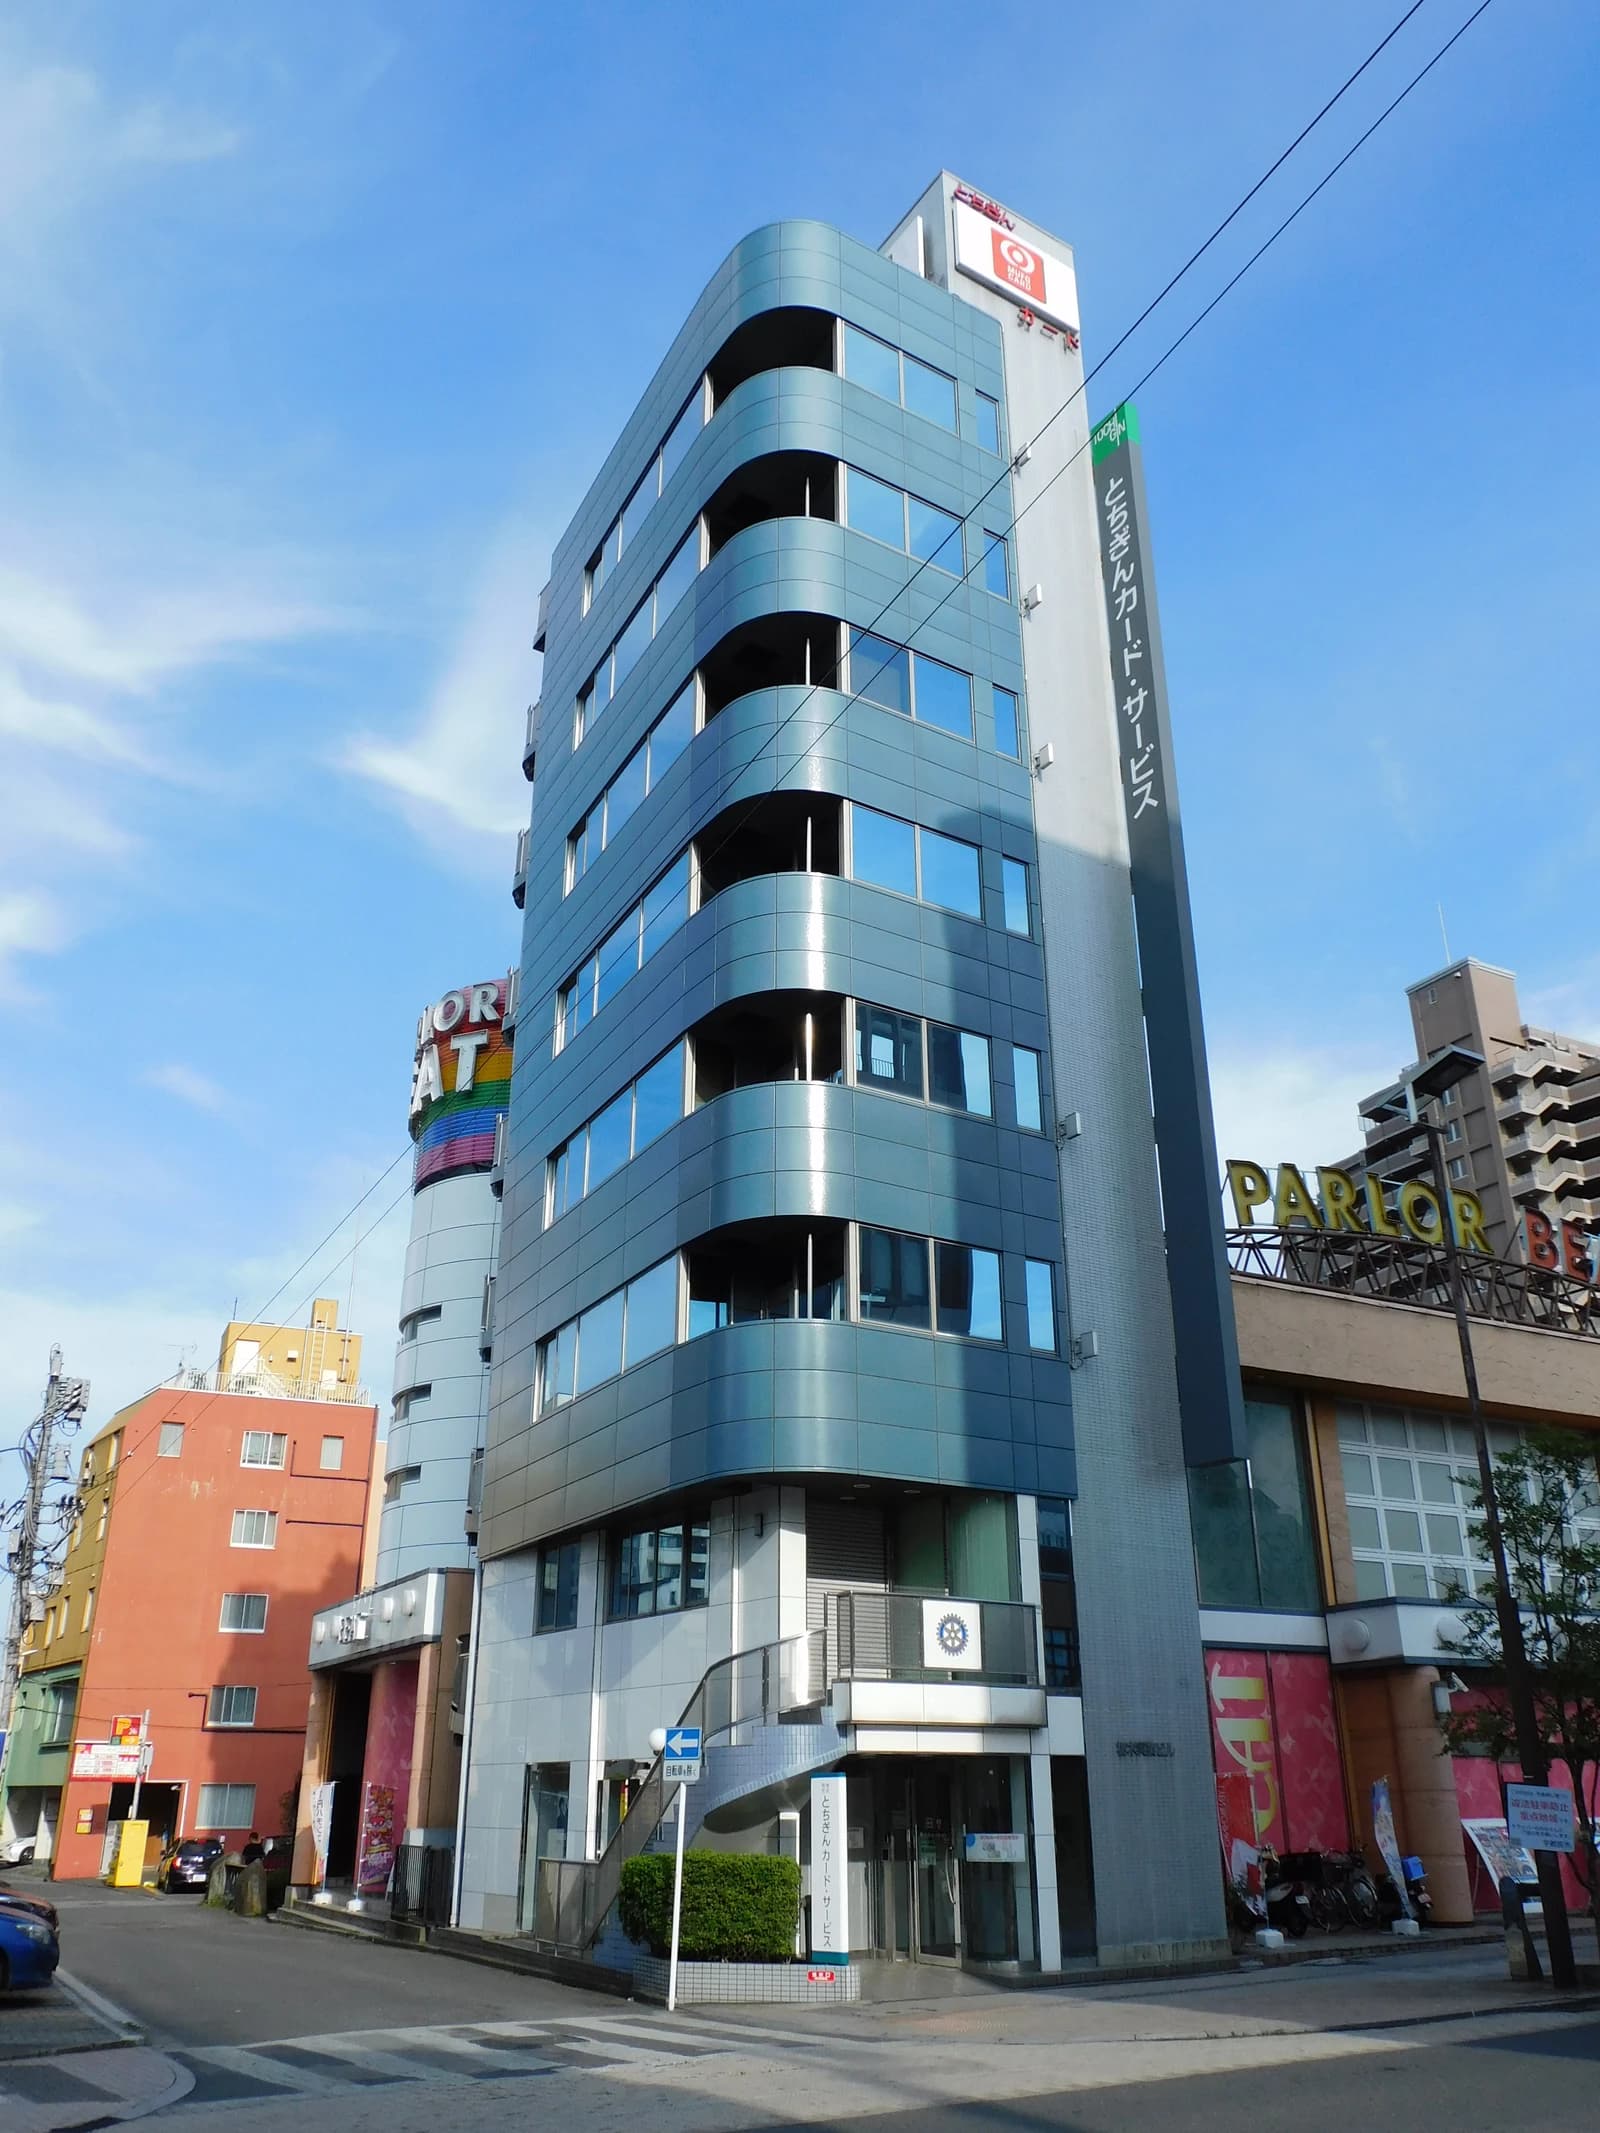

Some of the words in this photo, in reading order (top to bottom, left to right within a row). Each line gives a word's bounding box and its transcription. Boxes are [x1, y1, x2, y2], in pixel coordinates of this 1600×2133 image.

[1018, 305, 1080, 352] カード
[1103, 476, 1159, 820] とちぎんカード・サービス
[1226, 1160, 1495, 1254] PARLOR
[820, 1795, 832, 1948] とちぎんカード・サービス
